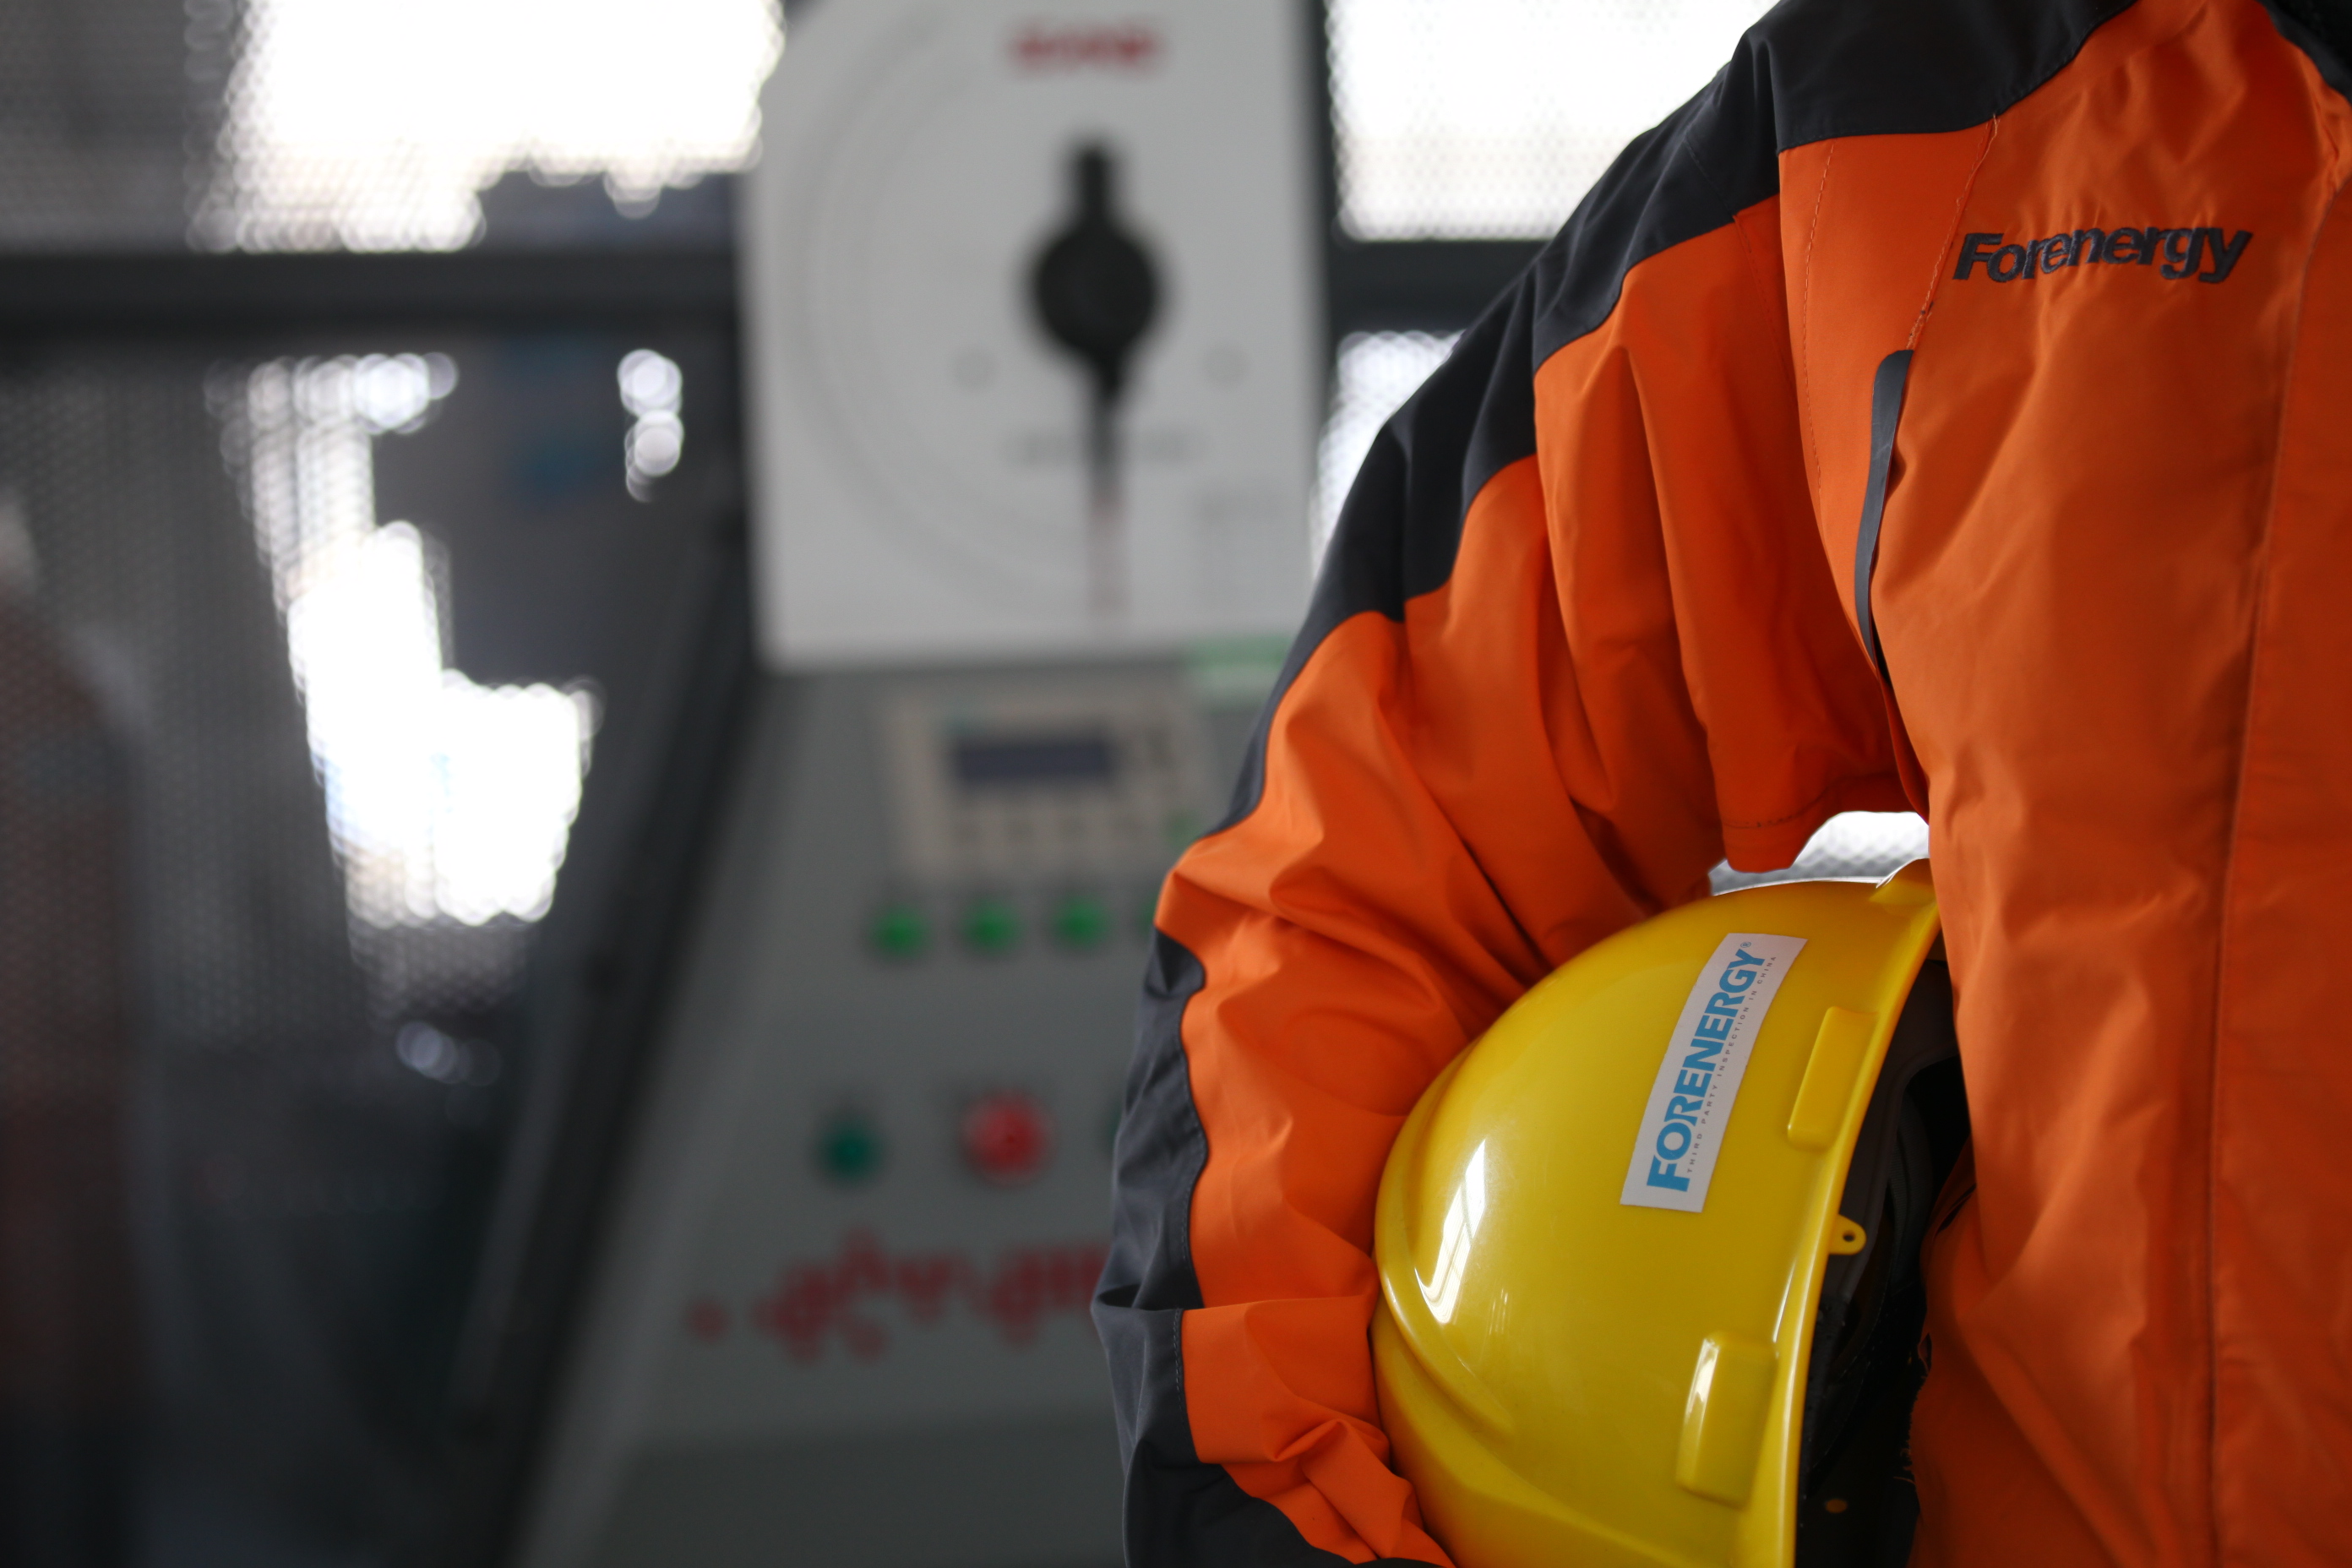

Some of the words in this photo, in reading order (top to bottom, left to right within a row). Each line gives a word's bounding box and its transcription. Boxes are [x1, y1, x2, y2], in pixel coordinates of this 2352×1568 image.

[1952, 226, 2253, 284] Forenergy
[1686, 1133, 1702, 1173] THIRD
[1701, 1085, 1718, 1124] PARTY
[1717, 1007, 1749, 1076] INSPECTION
[1749, 990, 1757, 1000] IN
[1757, 956, 1777, 984] CHINA
